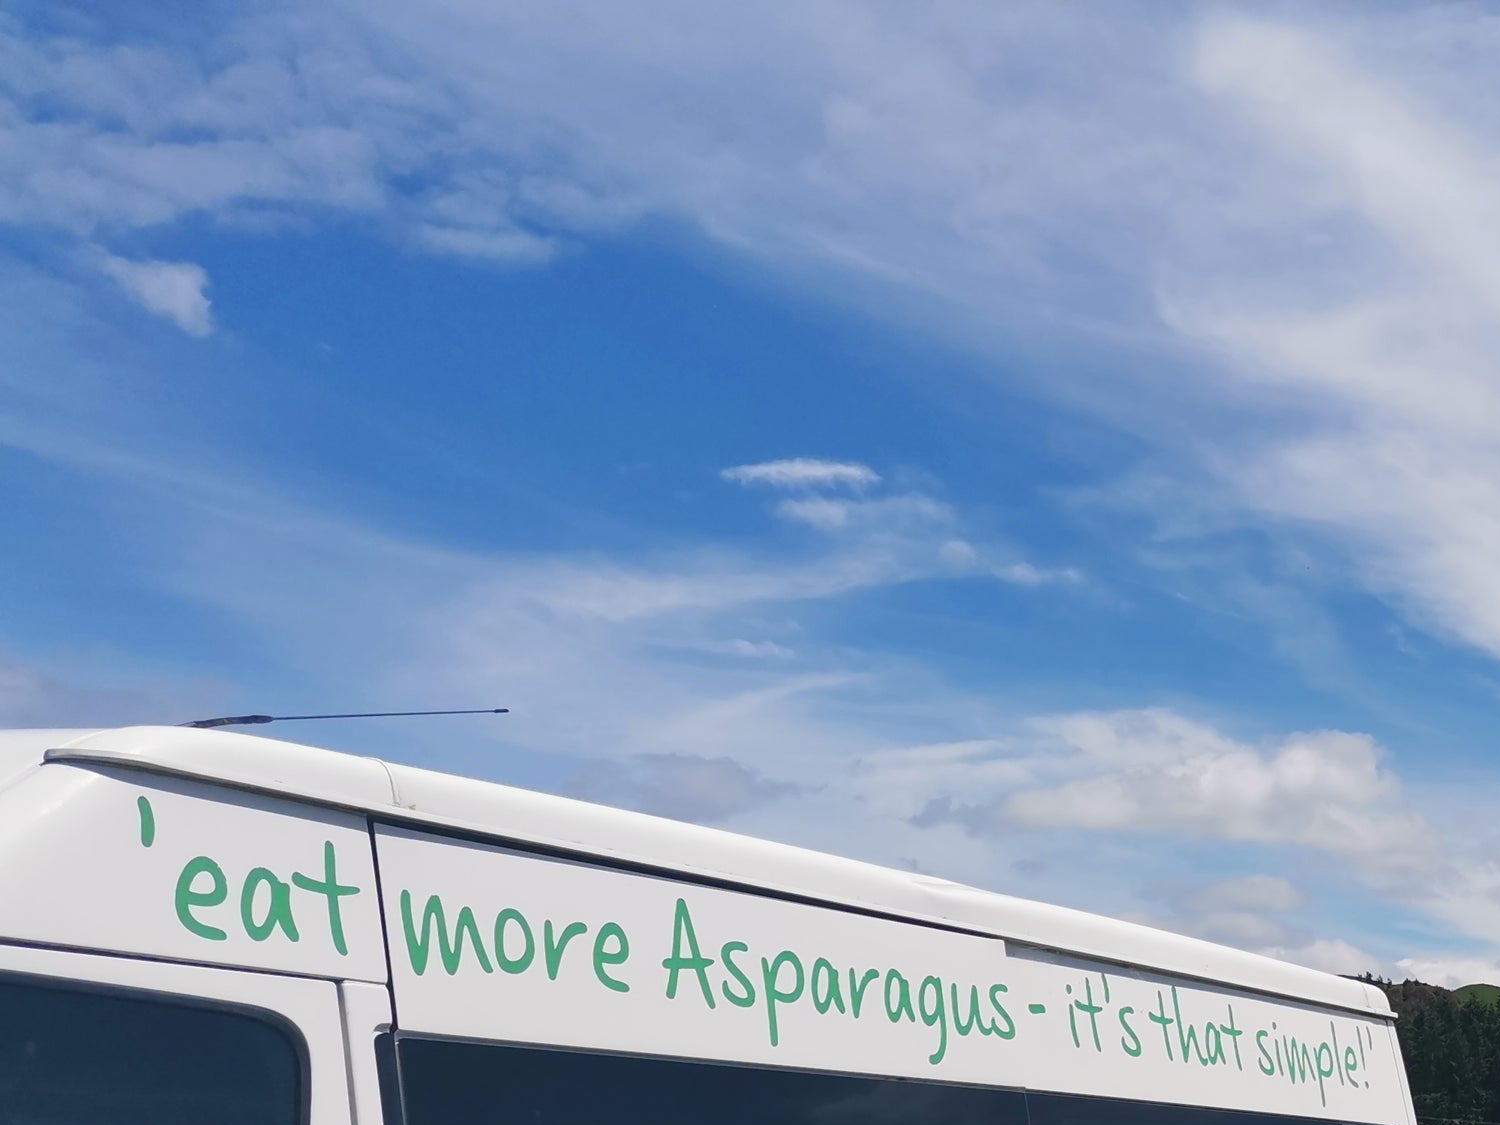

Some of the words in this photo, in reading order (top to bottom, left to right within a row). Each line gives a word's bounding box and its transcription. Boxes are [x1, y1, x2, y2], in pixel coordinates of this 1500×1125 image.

[137, 796, 360, 956] 'eat
[400, 889, 631, 992] more
[662, 898, 1016, 1065] Asparagus
[1066, 972, 1142, 1057] it's
[1148, 985, 1243, 1071] that
[1256, 1020, 1373, 1107] simple!'
